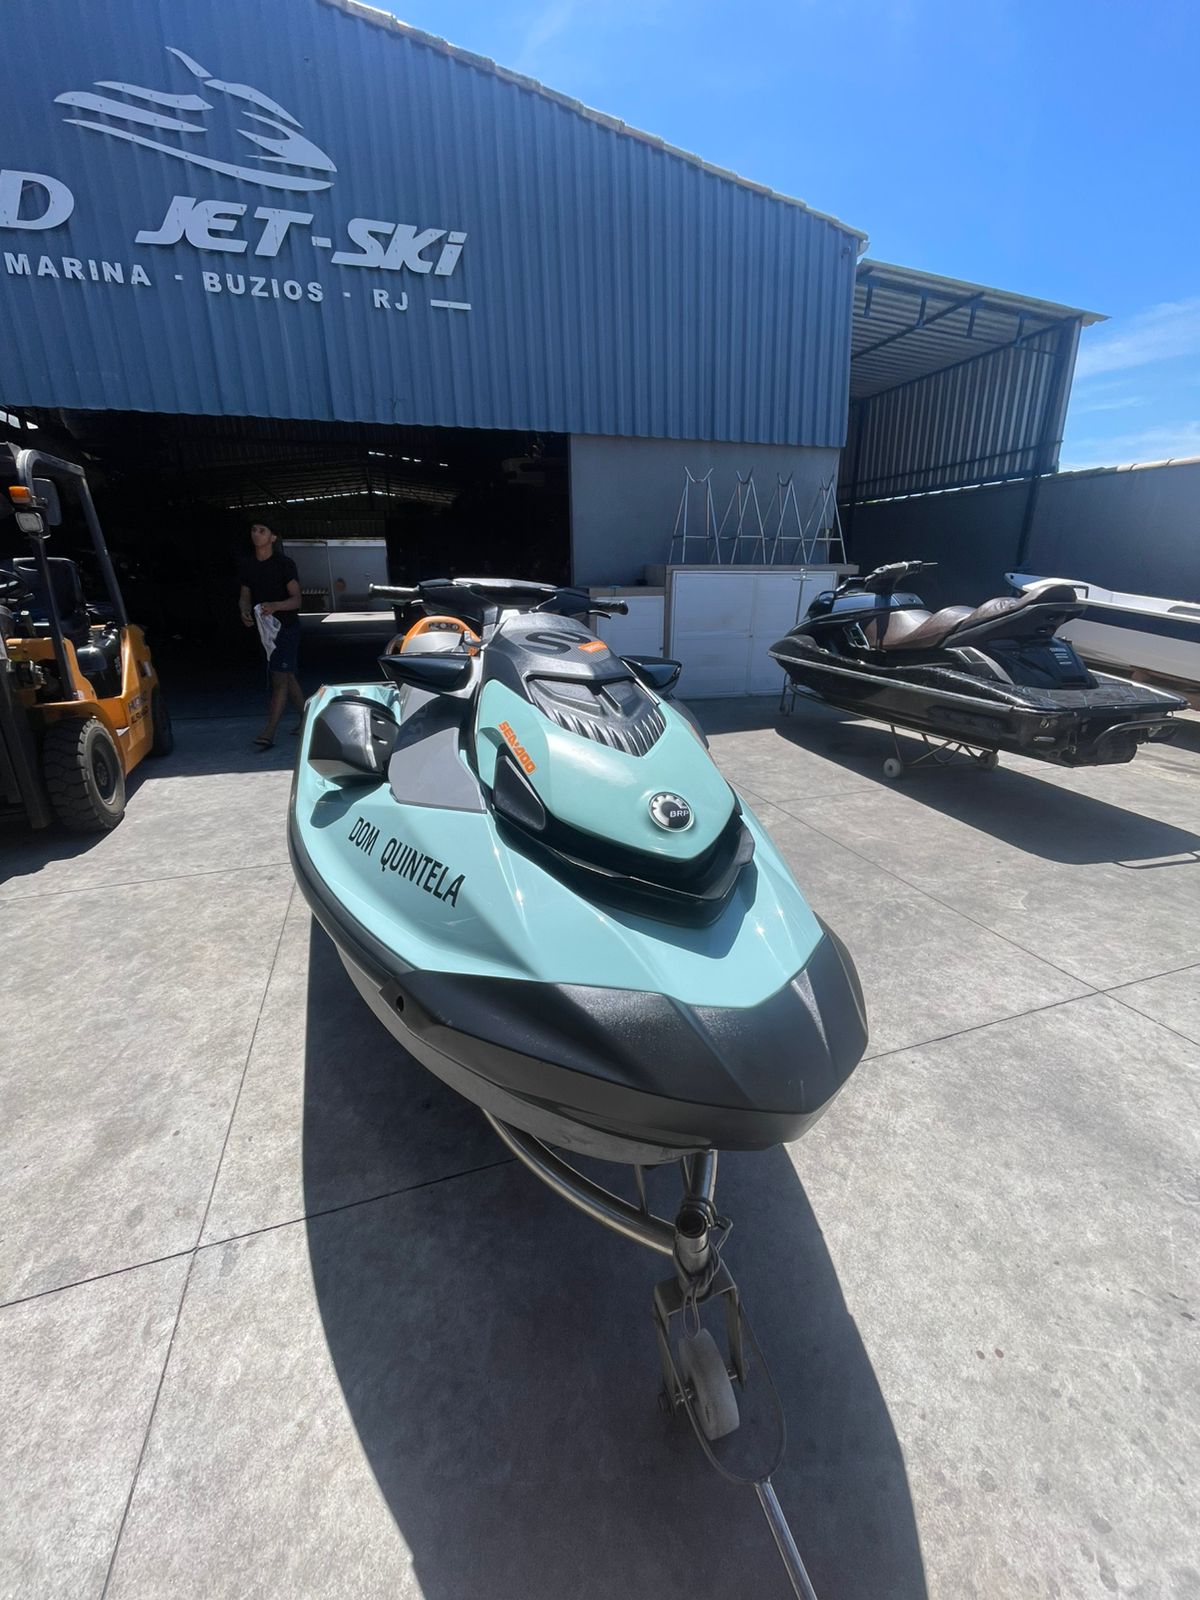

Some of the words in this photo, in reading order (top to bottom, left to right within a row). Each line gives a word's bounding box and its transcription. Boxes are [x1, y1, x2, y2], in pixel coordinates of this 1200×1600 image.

[4, 251, 151, 287] MARINA
[202, 270, 324, 303] BUZIOS
[373, 288, 409, 311] RJ
[669, 809, 689, 818] BRP
[348, 816, 380, 856] DOM
[380, 837, 466, 908] QUINTELA
